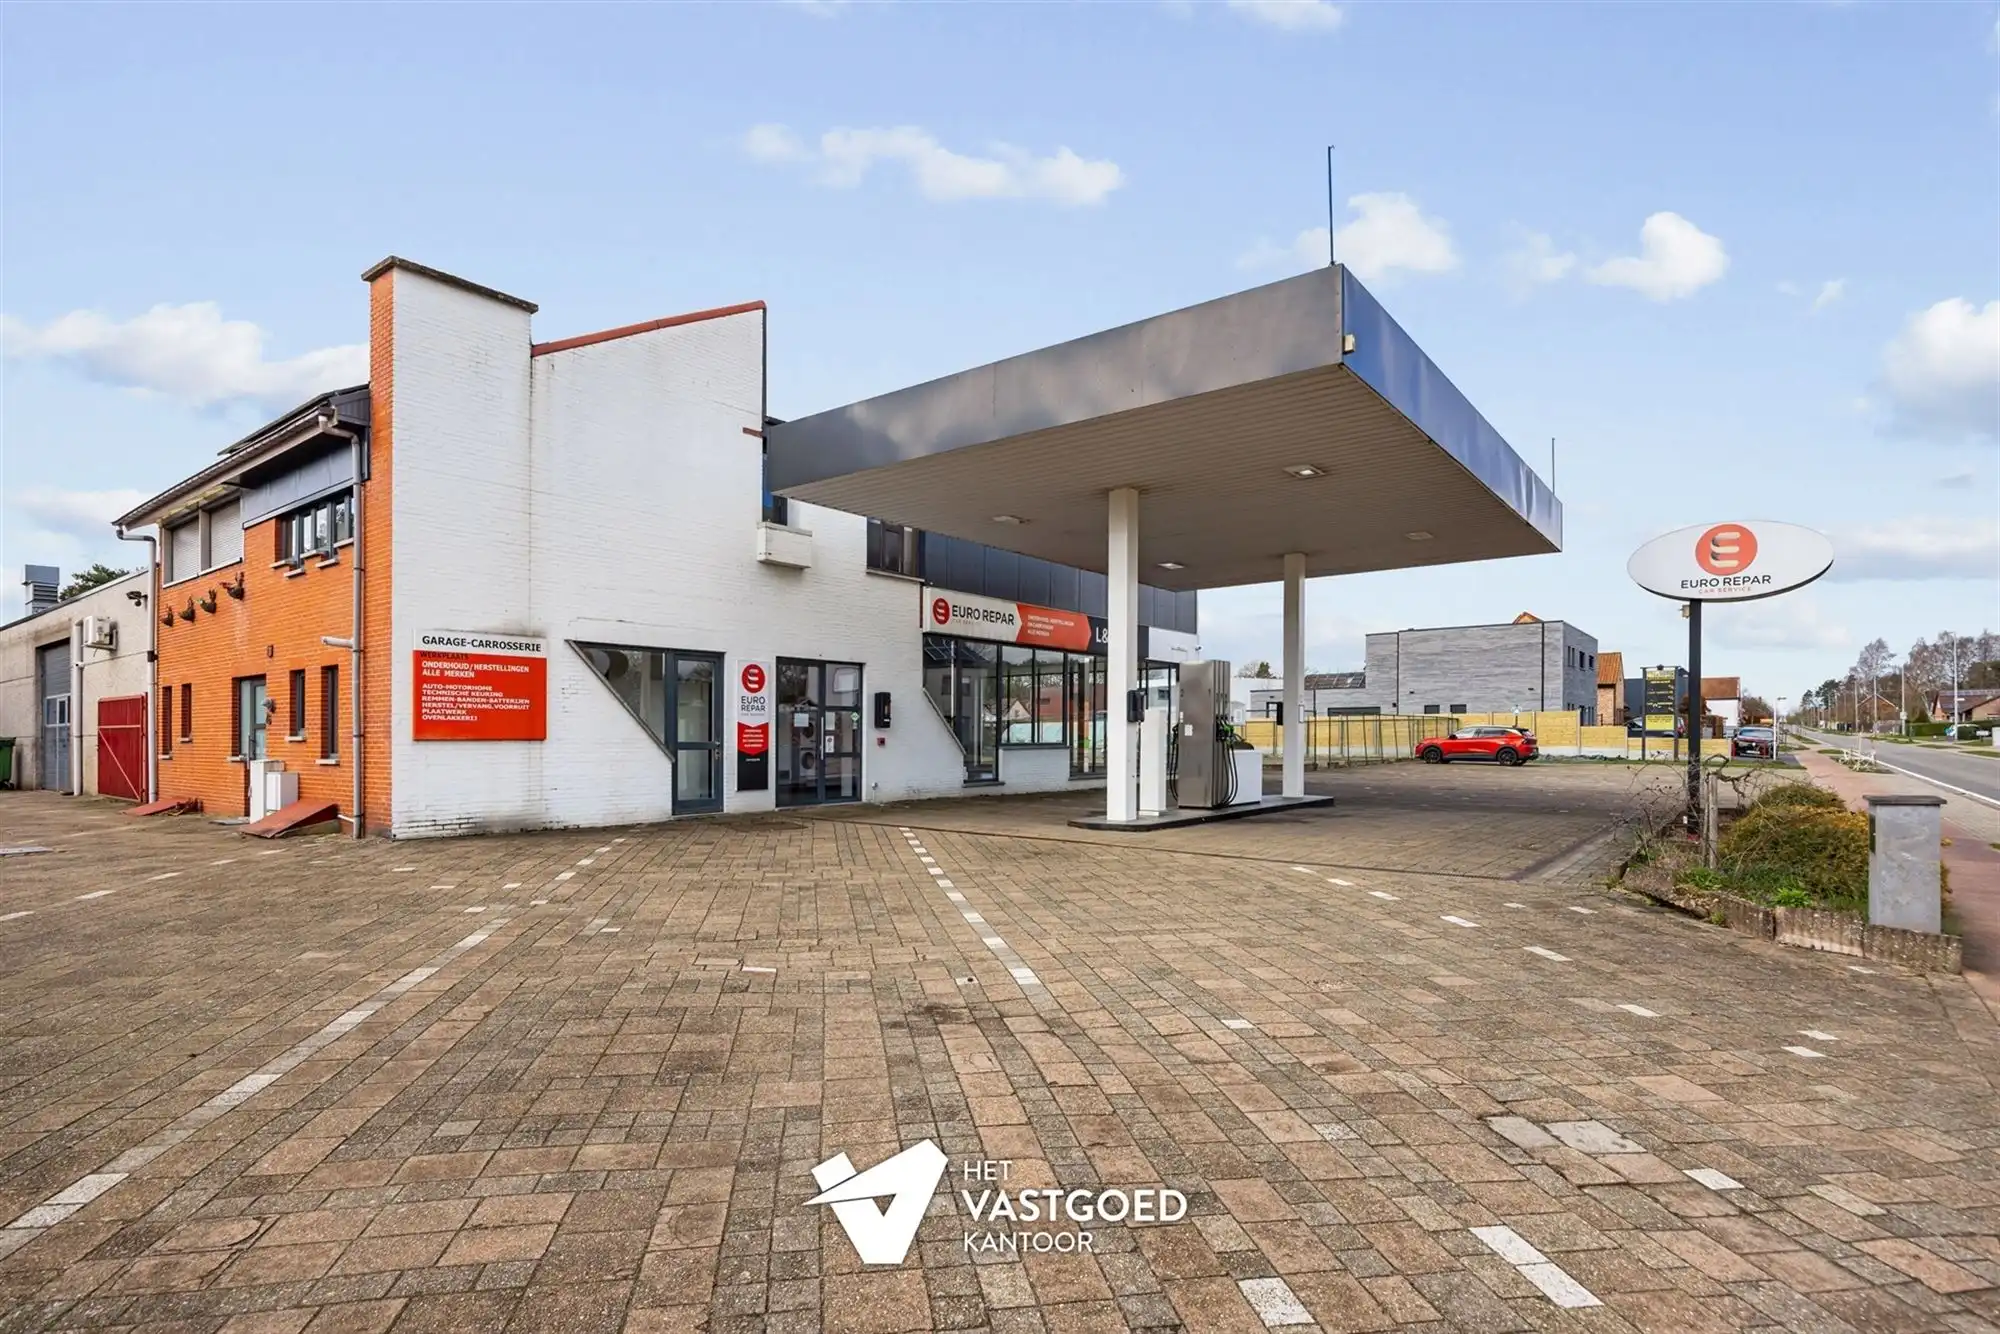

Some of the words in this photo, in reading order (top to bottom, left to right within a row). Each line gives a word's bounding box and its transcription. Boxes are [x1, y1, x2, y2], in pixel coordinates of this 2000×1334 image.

[1680, 577, 1720, 589] EURO
[1722, 575, 1772, 587] REPAR
[951, 605, 981, 621] EURO
[982, 609, 1015, 626] REPAR
[422, 635, 542, 652] GARAGE-CARROSSERIE
[444, 670, 475, 678] MERKEN
[741, 696, 766, 704] EURO
